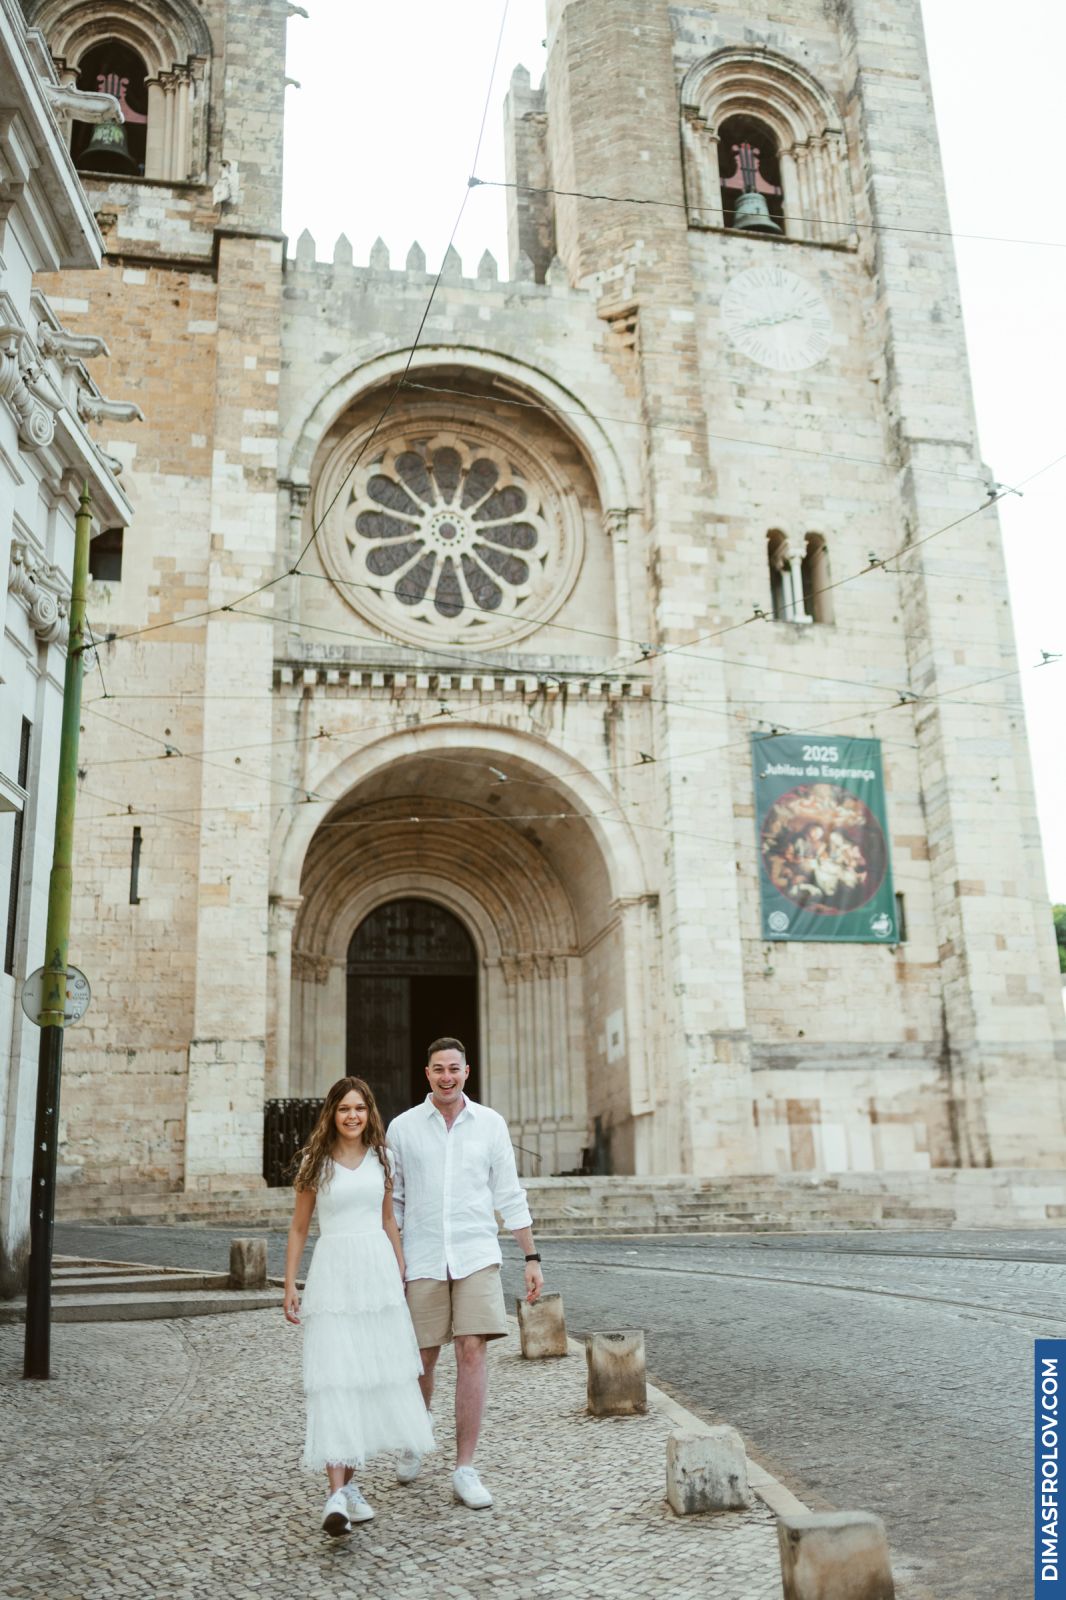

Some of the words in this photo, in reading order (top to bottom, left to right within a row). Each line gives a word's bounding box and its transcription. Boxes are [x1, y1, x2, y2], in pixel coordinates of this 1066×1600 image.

[802, 745, 838, 762] 2025
[765, 763, 804, 776] Jubileu
[806, 765, 819, 776] da
[822, 765, 875, 781] Esperança
